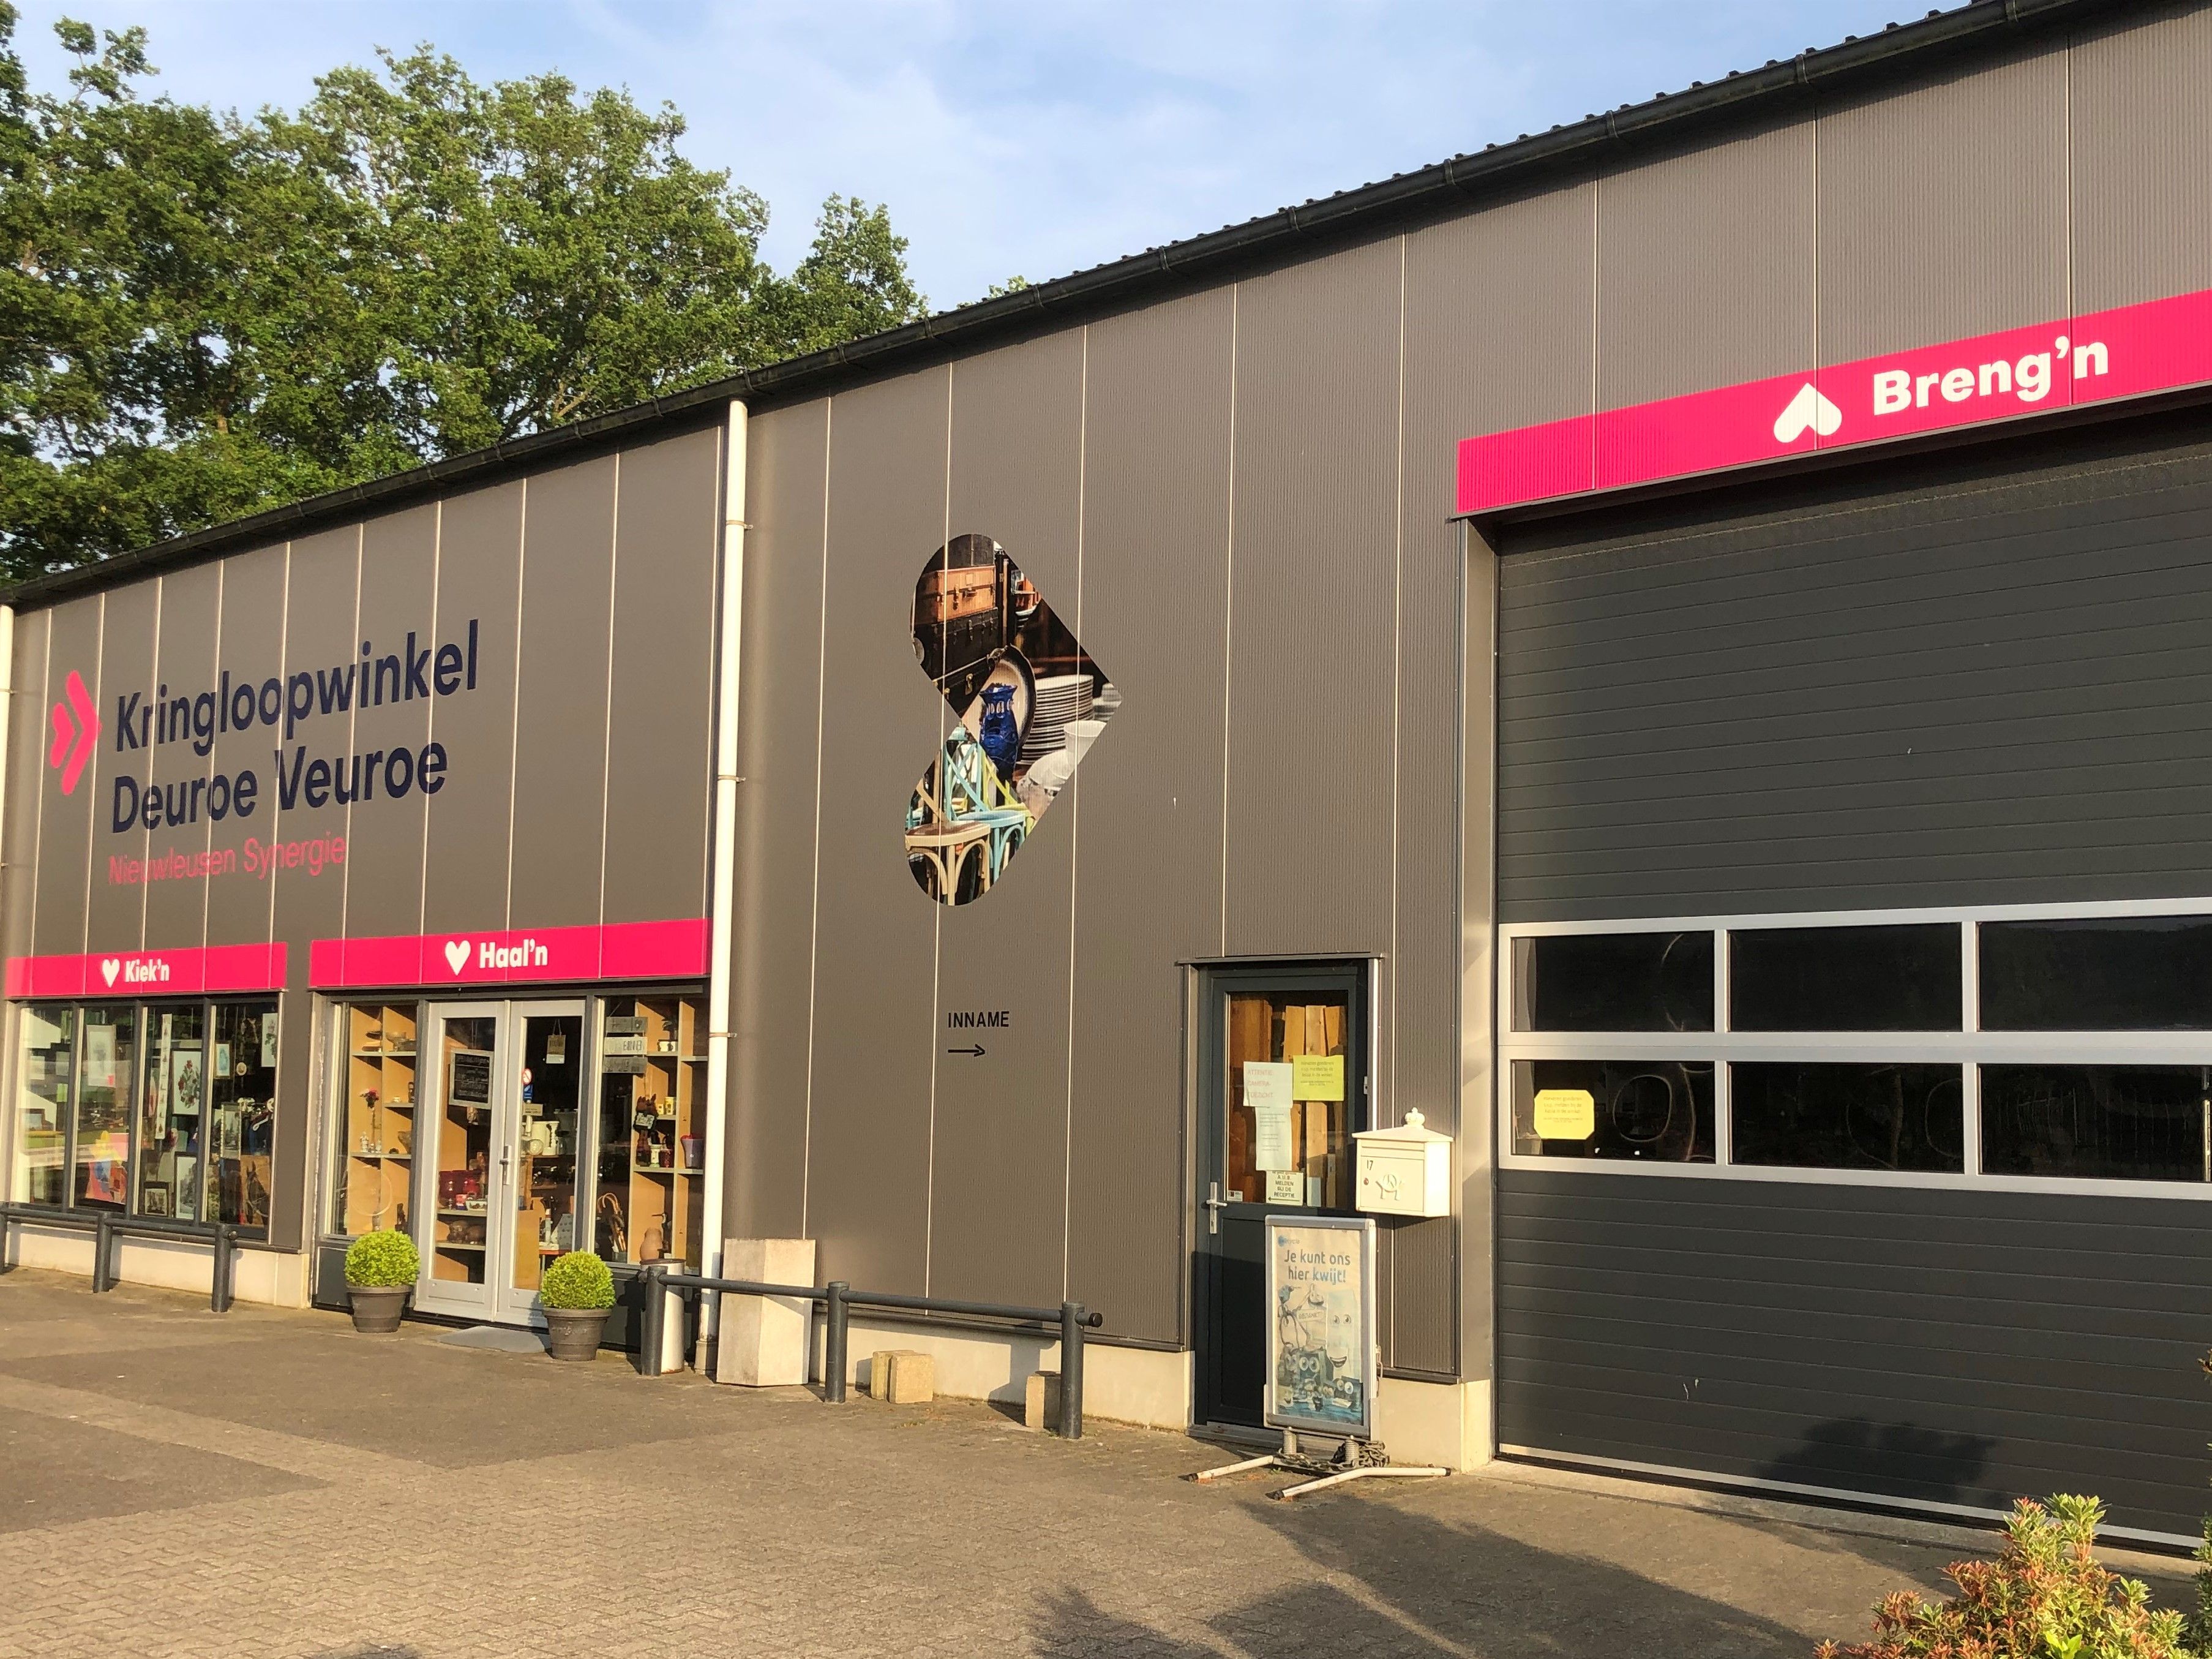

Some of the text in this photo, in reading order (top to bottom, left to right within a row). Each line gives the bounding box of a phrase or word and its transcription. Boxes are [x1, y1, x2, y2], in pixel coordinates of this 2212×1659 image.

[1873, 336, 2109, 416] Breng’n
[116, 619, 479, 757] Kringloopwinkel
[113, 742, 448, 833] Deuroe Veuroe
[108, 831, 345, 886] Nieuwleusen Synergie
[479, 938, 548, 969] Haal’n
[125, 958, 170, 982] Kiek’n
[948, 1010, 1010, 1028] INNAME
[1367, 1159, 1373, 1170] 17
[1284, 1249, 1351, 1265] Je kunt ons
[1288, 1265, 1346, 1285] hier kwijt!
